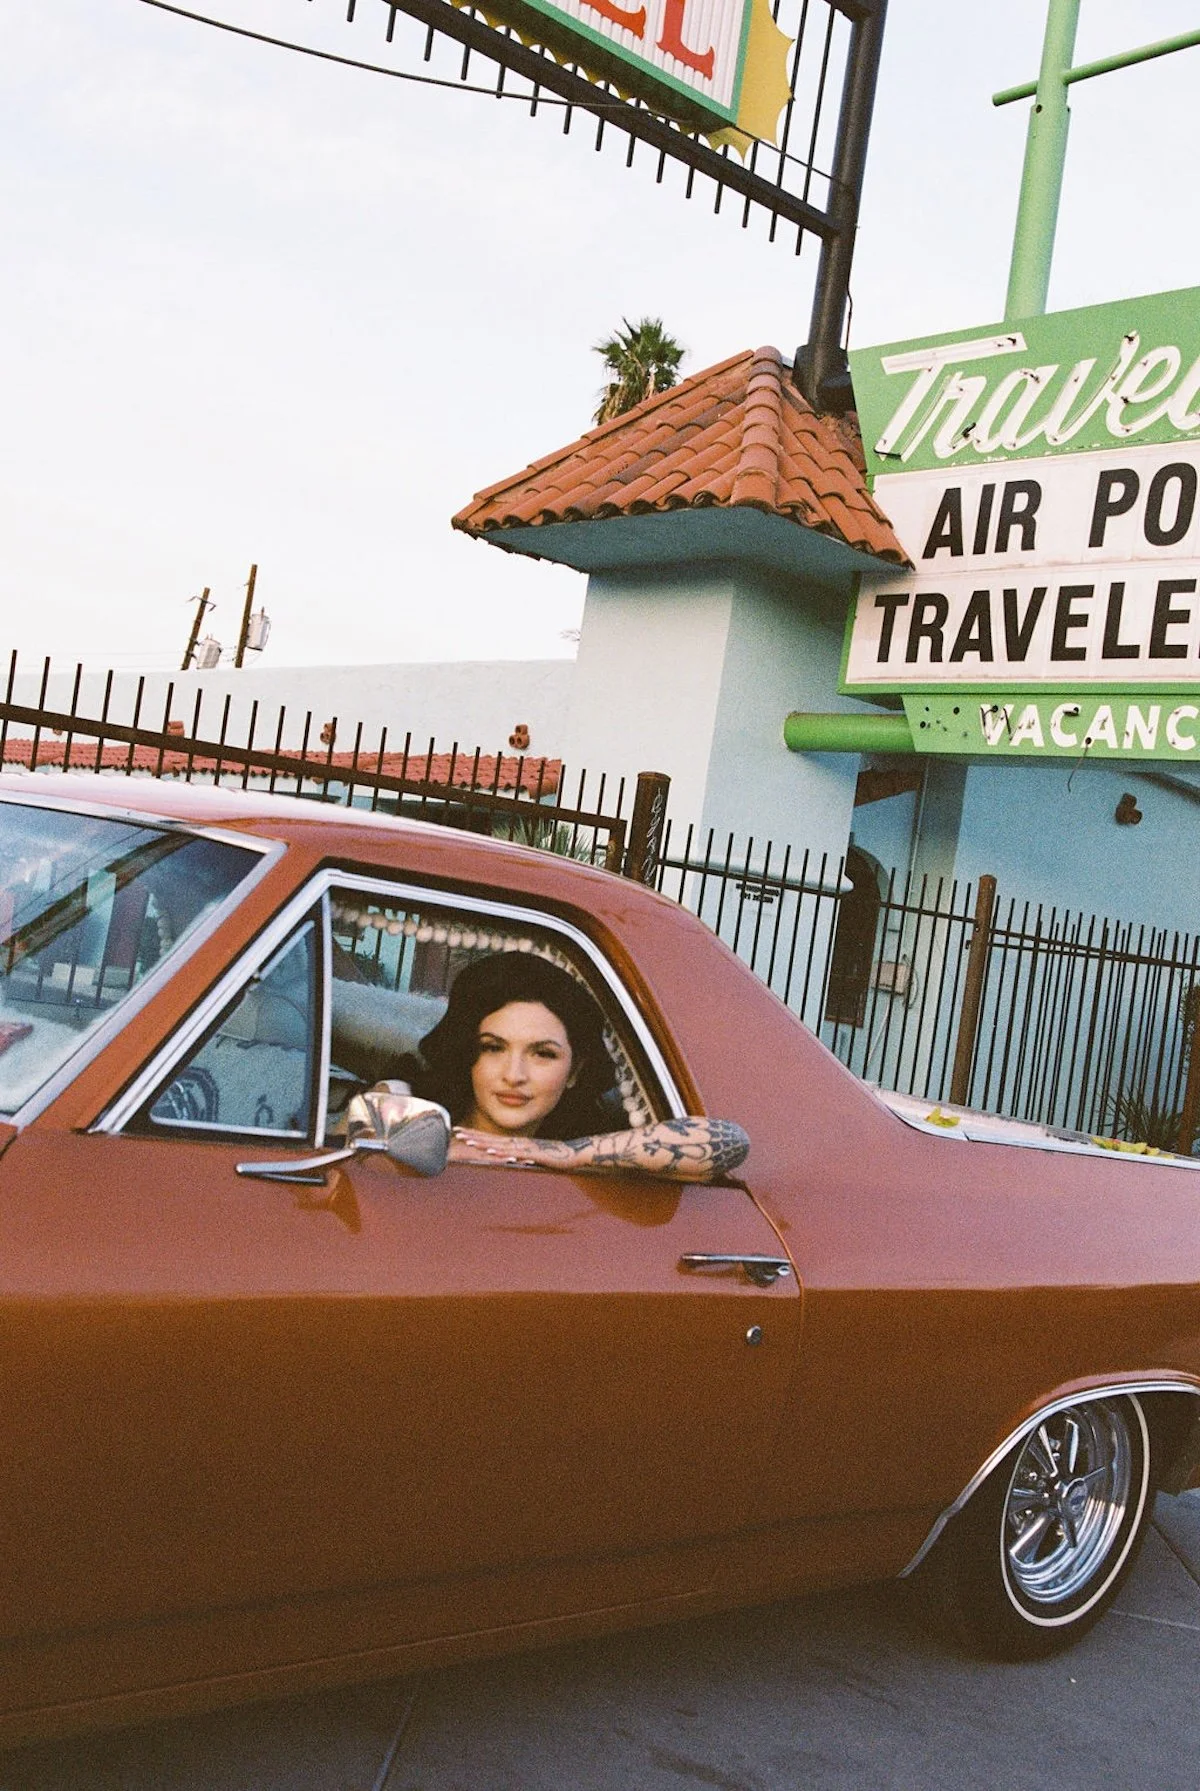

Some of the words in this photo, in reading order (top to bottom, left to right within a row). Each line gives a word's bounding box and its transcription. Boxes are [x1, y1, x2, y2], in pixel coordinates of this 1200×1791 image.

[922, 479, 1042, 560] AIR
[1088, 462, 1198, 548] PO
[874, 579, 1200, 663] TRAVELE
[980, 703, 1199, 749] VACANC
